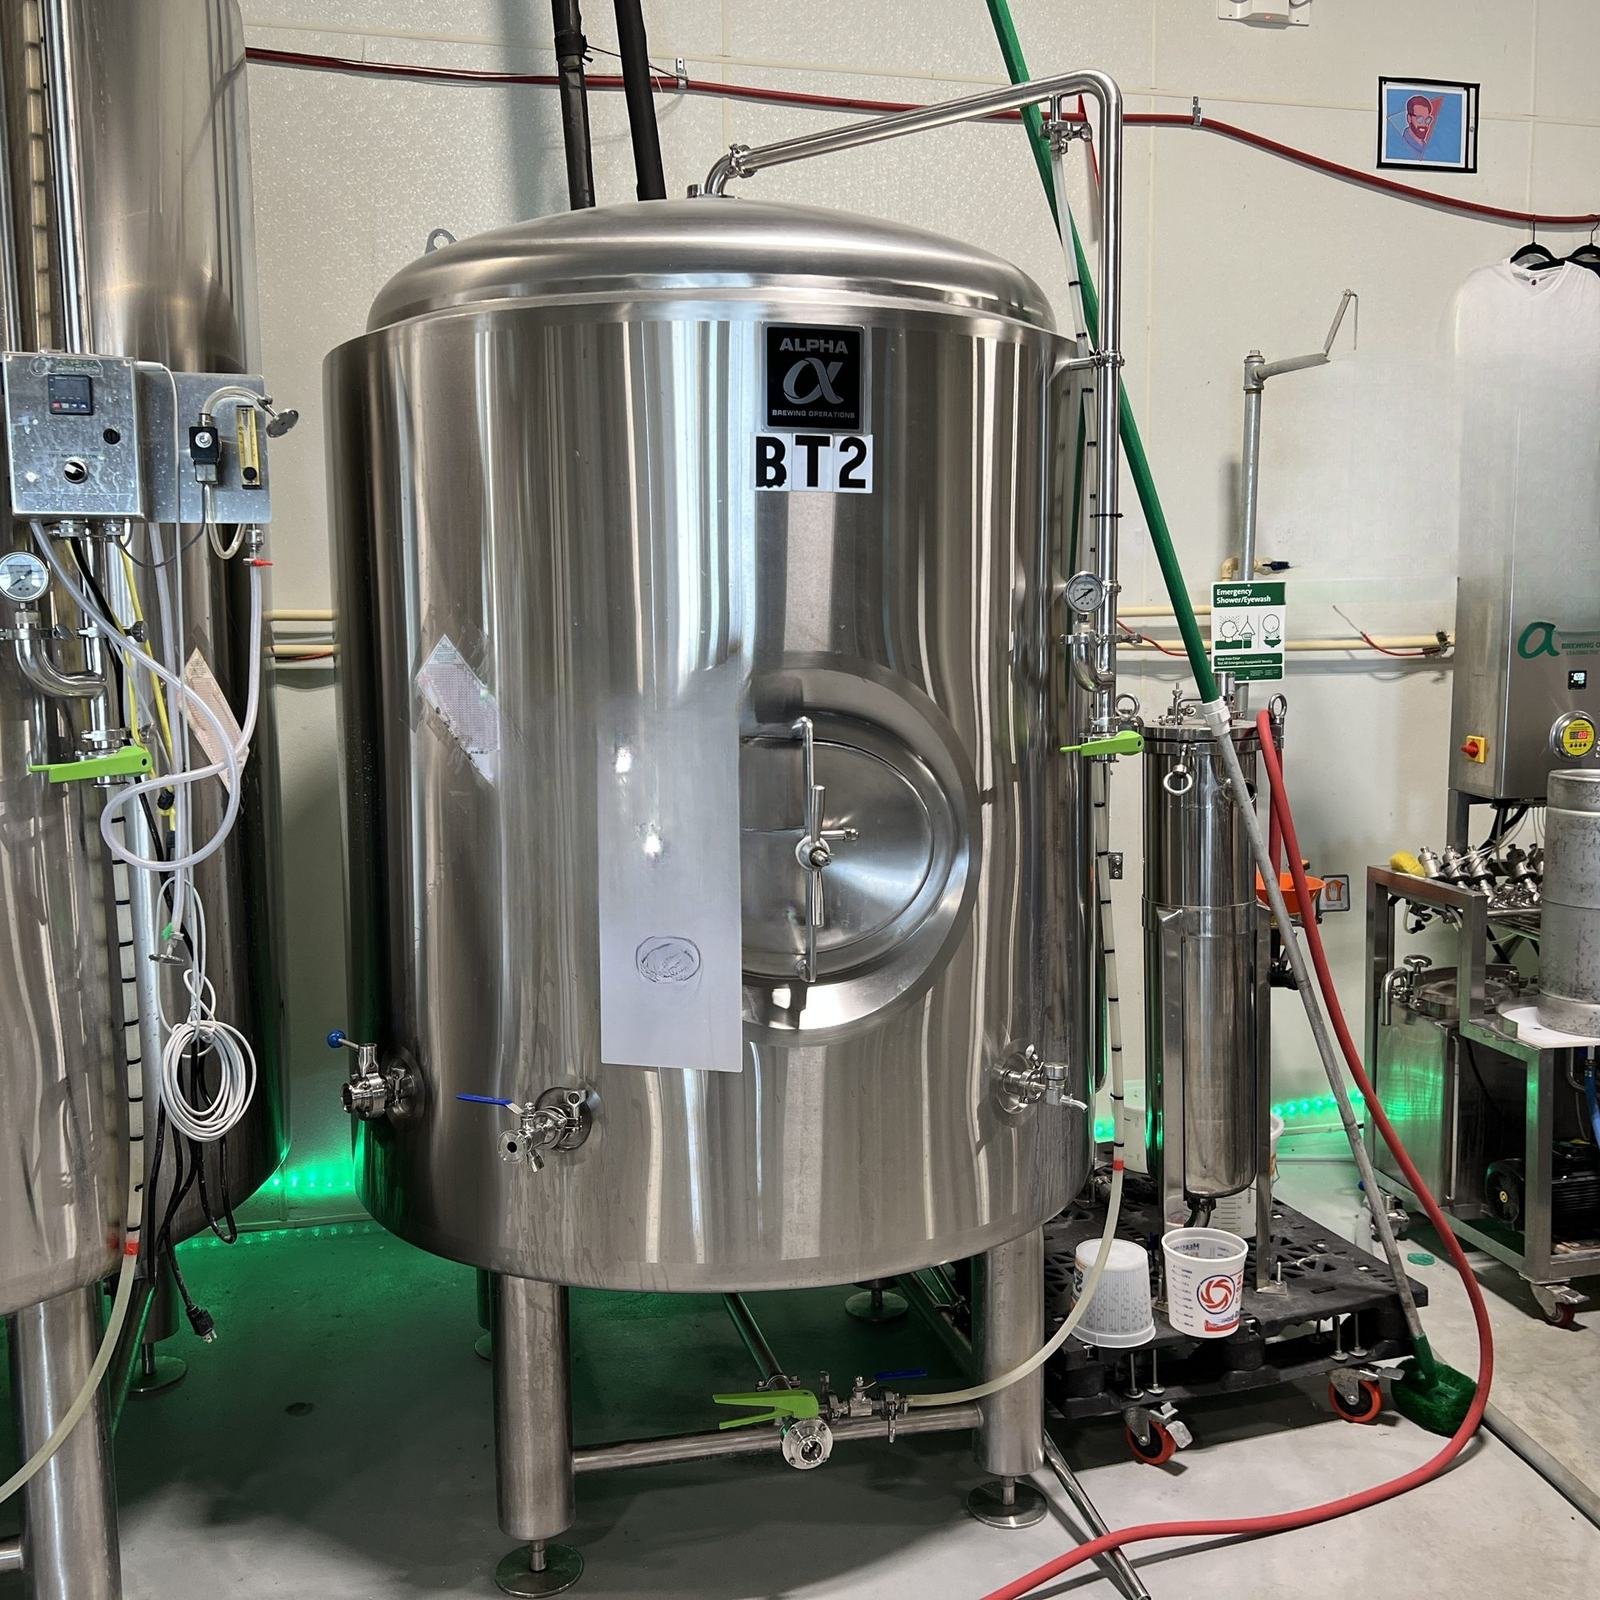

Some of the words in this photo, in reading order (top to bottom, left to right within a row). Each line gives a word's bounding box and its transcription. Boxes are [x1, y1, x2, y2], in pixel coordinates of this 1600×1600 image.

[779, 337, 848, 354] ALPHA
[771, 409, 807, 417] BREWING
[808, 409, 856, 419] OPERATIONS
[755, 435, 867, 489] BT2
[1216, 588, 1253, 597] Emergency
[1216, 595, 1272, 605] Shower/Eyewash
